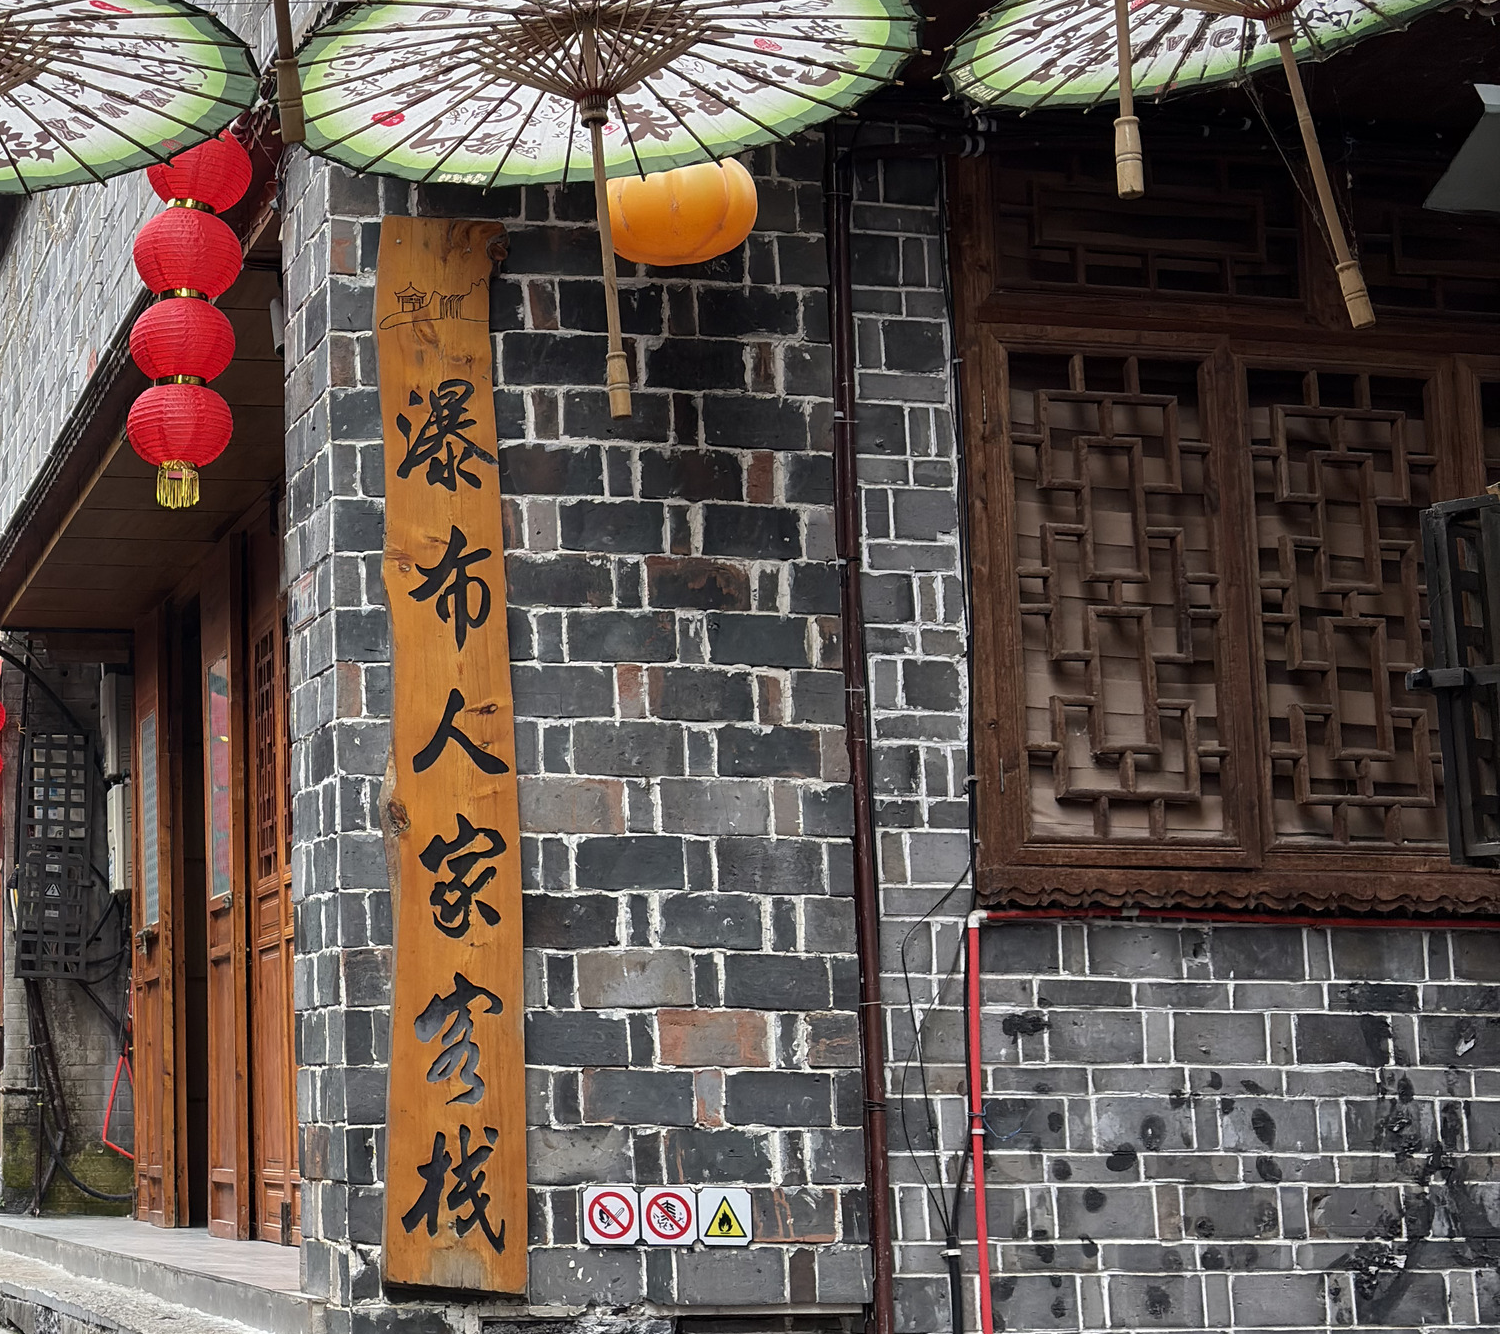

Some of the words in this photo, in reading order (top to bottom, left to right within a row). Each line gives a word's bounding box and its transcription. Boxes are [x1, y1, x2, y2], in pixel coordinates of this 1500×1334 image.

[396, 378, 510, 1257] 瀑布人家客栈
